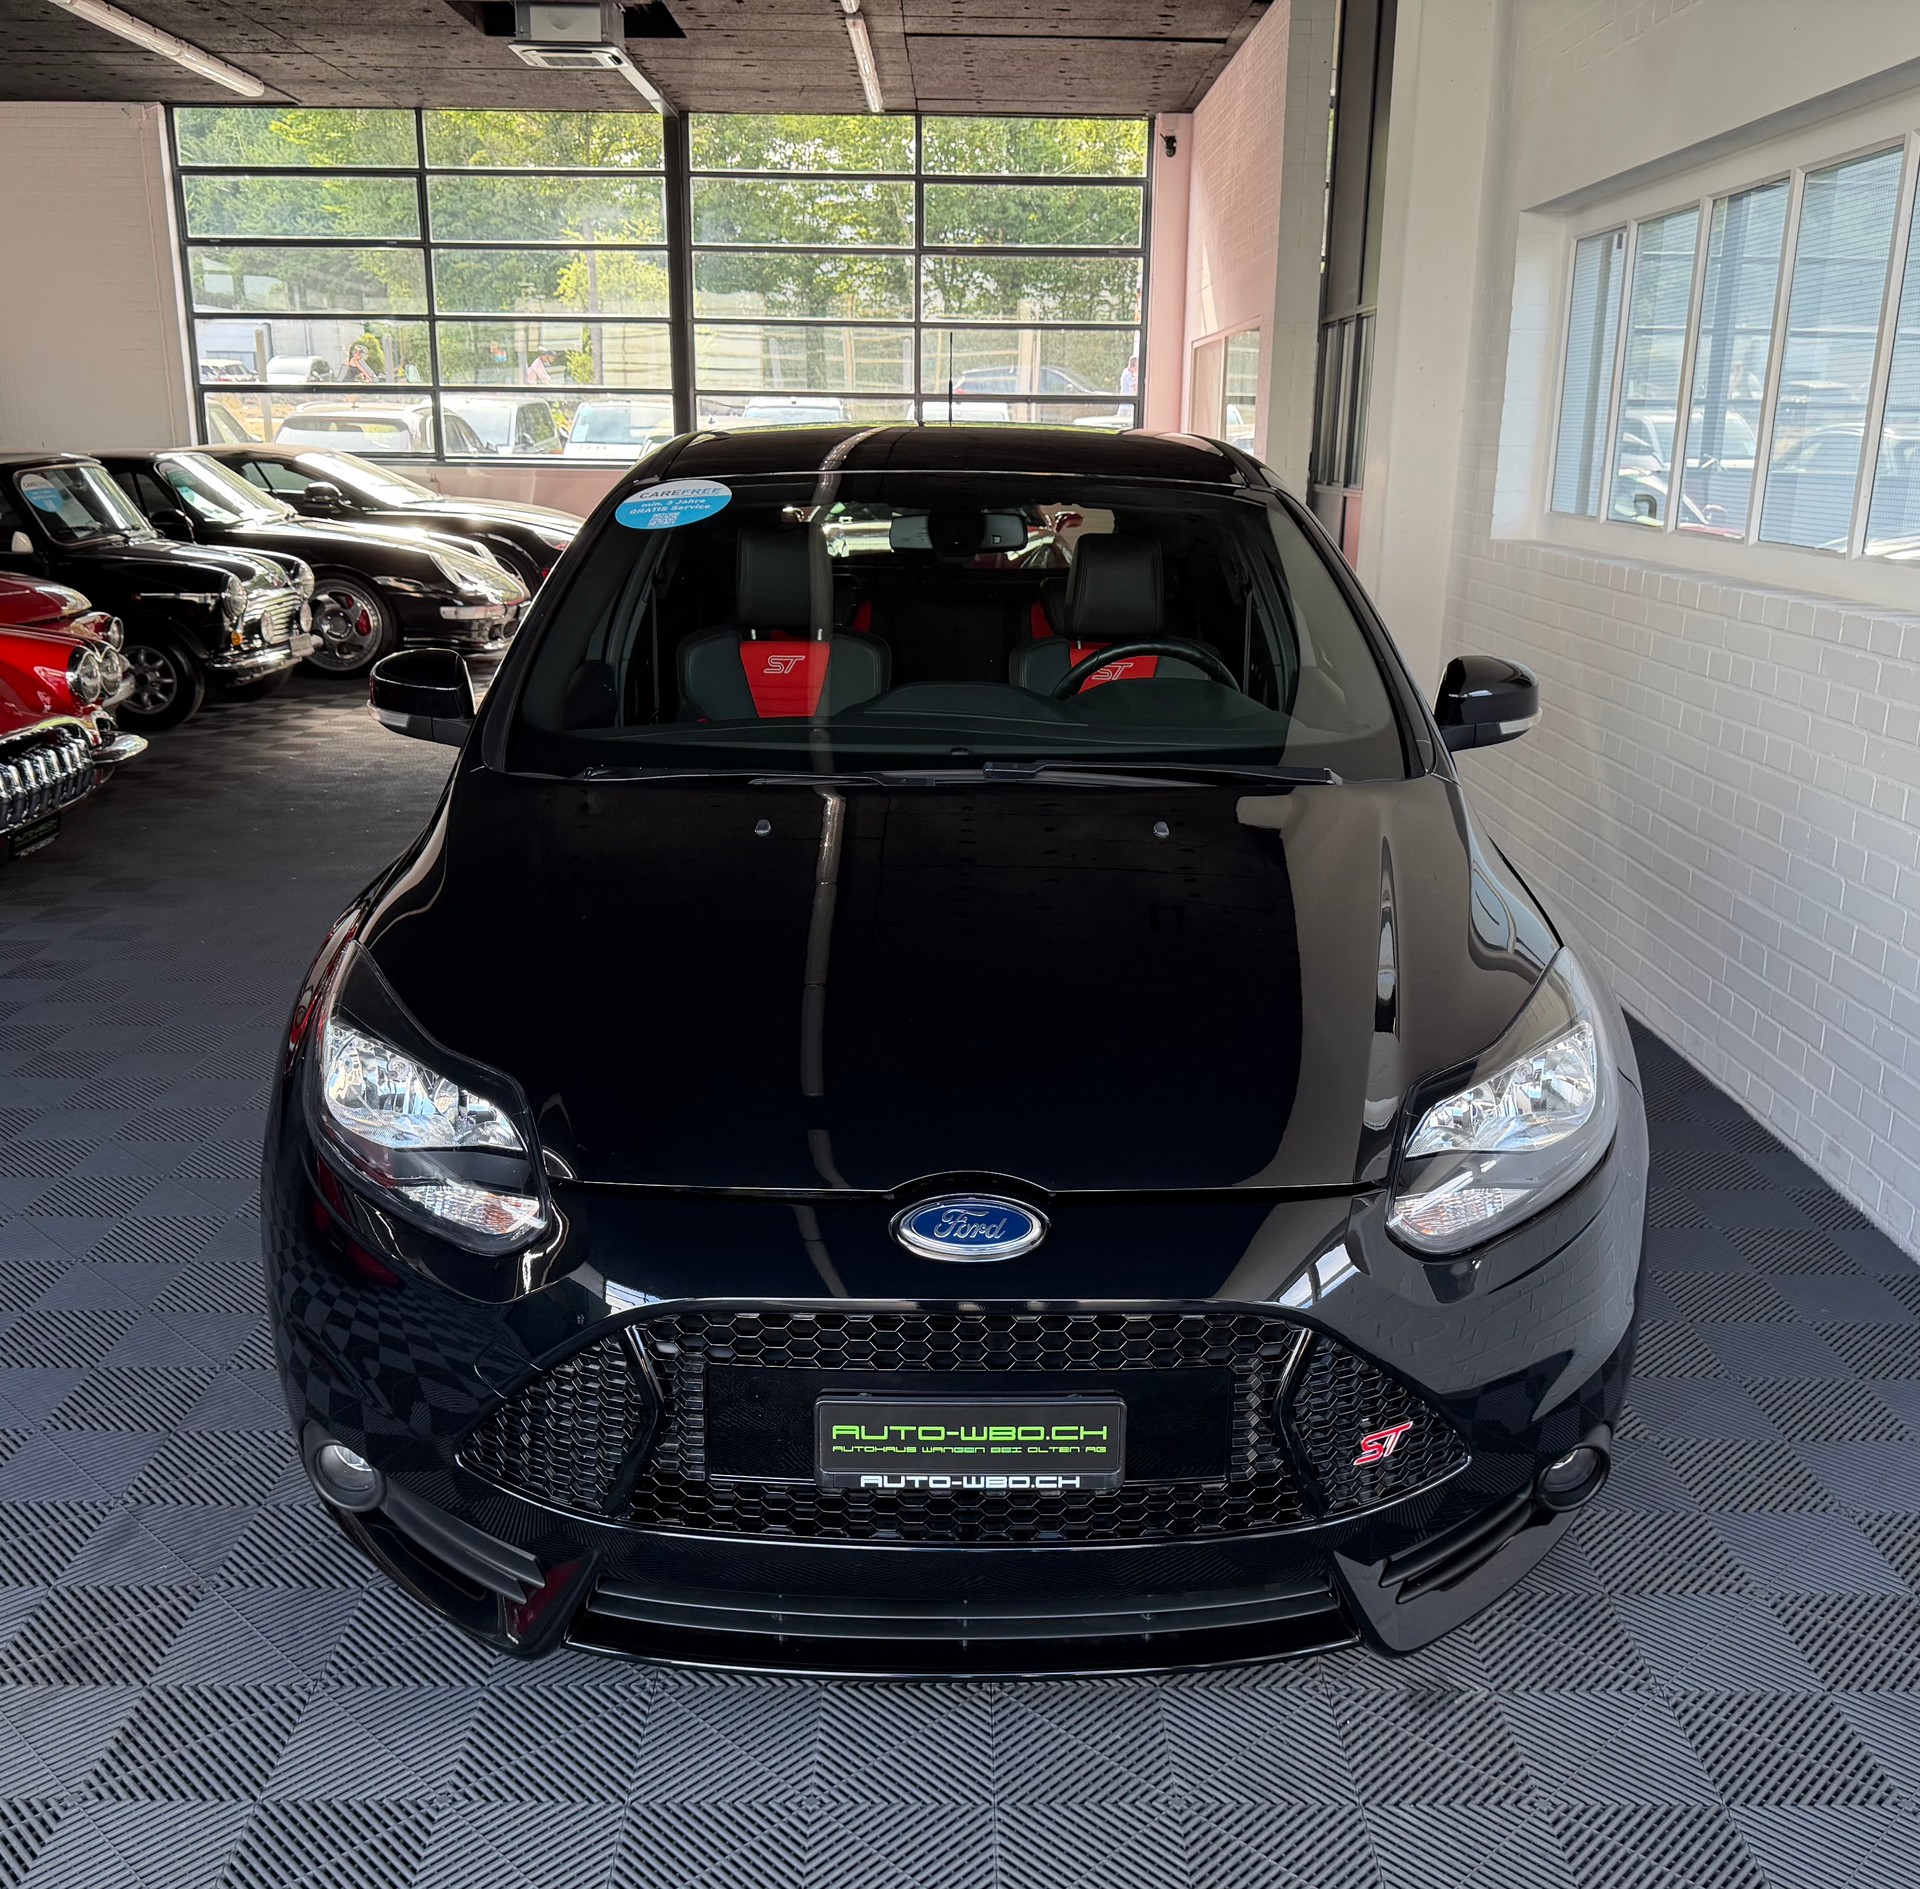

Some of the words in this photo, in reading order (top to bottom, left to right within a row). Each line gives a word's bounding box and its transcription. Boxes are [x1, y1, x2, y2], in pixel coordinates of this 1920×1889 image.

[640, 487, 723, 499] CAREFREE
[629, 506, 669, 515] GRATIS
[671, 503, 711, 511] Service
[763, 655, 806, 674] ST
[1092, 662, 1134, 680] ST
[933, 1208, 1008, 1239] Ford
[832, 1425, 1108, 1441] AUTO-WBO.CH
[921, 1446, 986, 1454] WANGEN
[990, 1446, 1023, 1454] BEI
[1027, 1446, 1081, 1454] OLTEN
[1353, 1420, 1414, 1466] ST
[860, 1475, 1081, 1489] AUTO-WBO.CH
